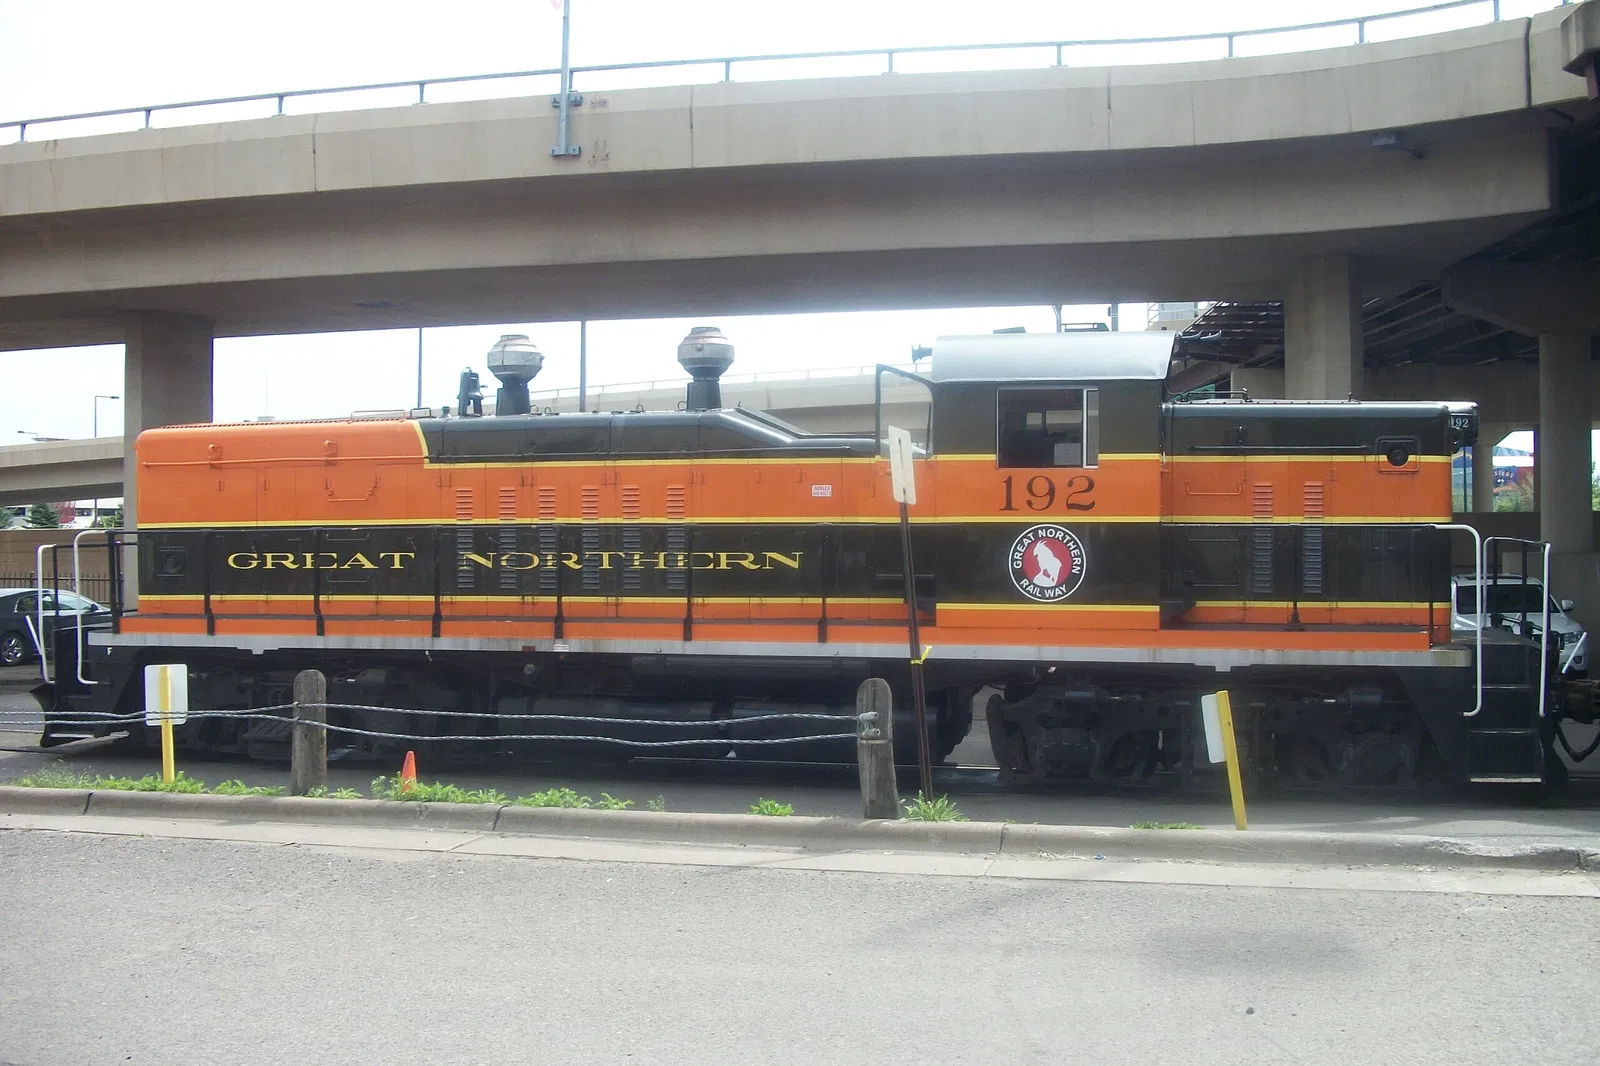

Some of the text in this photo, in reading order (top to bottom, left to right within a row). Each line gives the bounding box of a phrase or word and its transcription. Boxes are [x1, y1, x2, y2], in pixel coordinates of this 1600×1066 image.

[1451, 417, 1469, 428] 192
[999, 475, 1096, 511] 192
[227, 551, 804, 570] GREAT NORTHERN
[1013, 529, 1082, 574] GREAT NORTHERN
[107, 647, 113, 656] F
